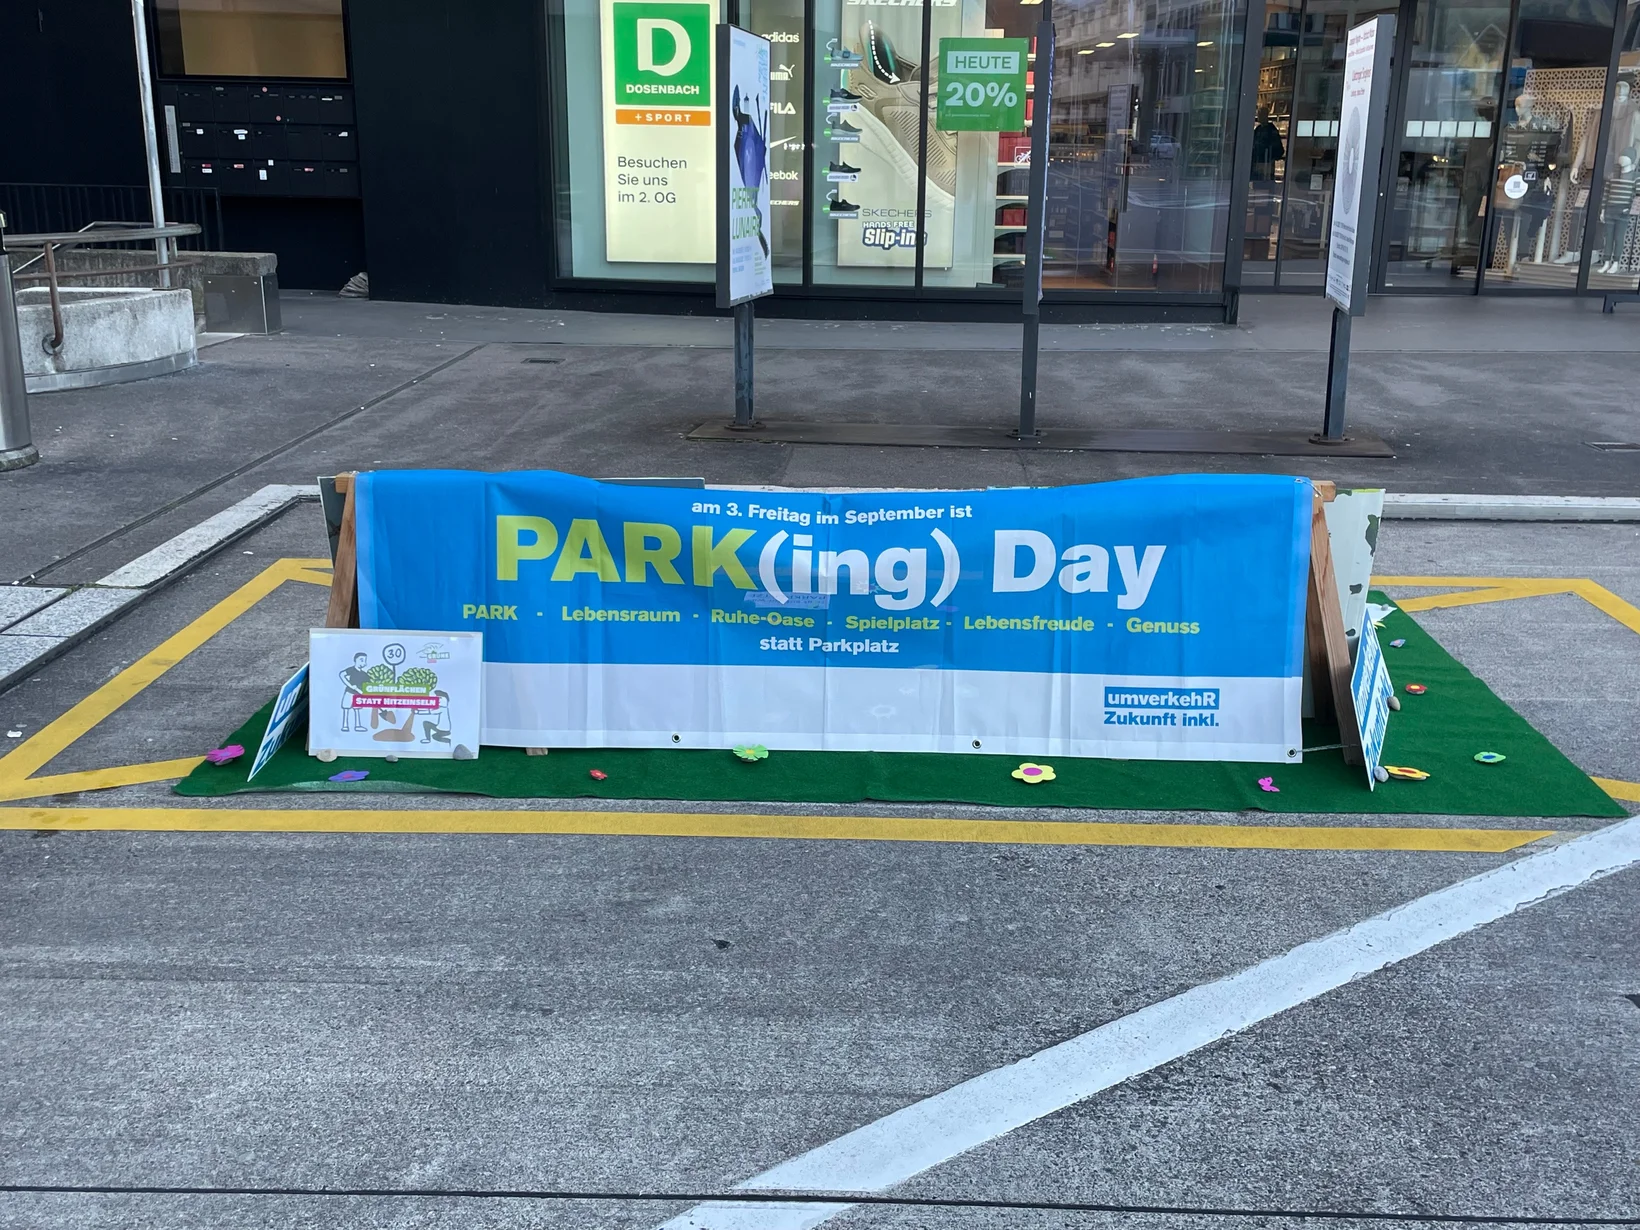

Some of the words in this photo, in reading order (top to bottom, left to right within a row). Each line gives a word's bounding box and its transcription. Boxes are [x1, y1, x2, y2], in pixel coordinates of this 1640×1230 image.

[636, 18, 692, 77] D
[955, 55, 1012, 69] HEUTE
[770, 71, 789, 81] UMA
[625, 83, 700, 95] DOSENBACH
[945, 81, 1018, 108] 20%
[617, 156, 688, 169] Besuchen
[617, 173, 639, 186] Sie
[643, 176, 669, 186] uns
[769, 169, 799, 181] eebok
[618, 190, 635, 203] im
[638, 191, 651, 203] 2.
[654, 191, 677, 204] OG
[863, 228, 927, 249] Slip-in
[691, 501, 721, 515] am
[725, 502, 743, 517] 3.
[747, 504, 811, 526] Freitag
[816, 511, 839, 524] im
[845, 505, 945, 526] September
[950, 504, 973, 518] ist
[496, 514, 961, 611] PARK(ing)
[992, 528, 1167, 611] Day
[462, 603, 519, 621] PARK
[562, 605, 681, 623] Lebensraum
[711, 608, 815, 629] Ruhe-Oase
[845, 615, 940, 633] Spielplatz
[963, 614, 1095, 633] Lebensfreude
[1126, 616, 1201, 635] Genuss
[759, 636, 803, 651] statt
[808, 637, 900, 655] Parkplatz
[386, 647, 402, 659] 30
[365, 684, 427, 693] GRÜNFLÄCHEN
[355, 697, 382, 705] STATT
[383, 698, 436, 706] HITZEINSELN
[1107, 691, 1217, 707] umverkehR
[1103, 710, 1177, 726] Zukunft
[1182, 713, 1220, 727] inkl.
